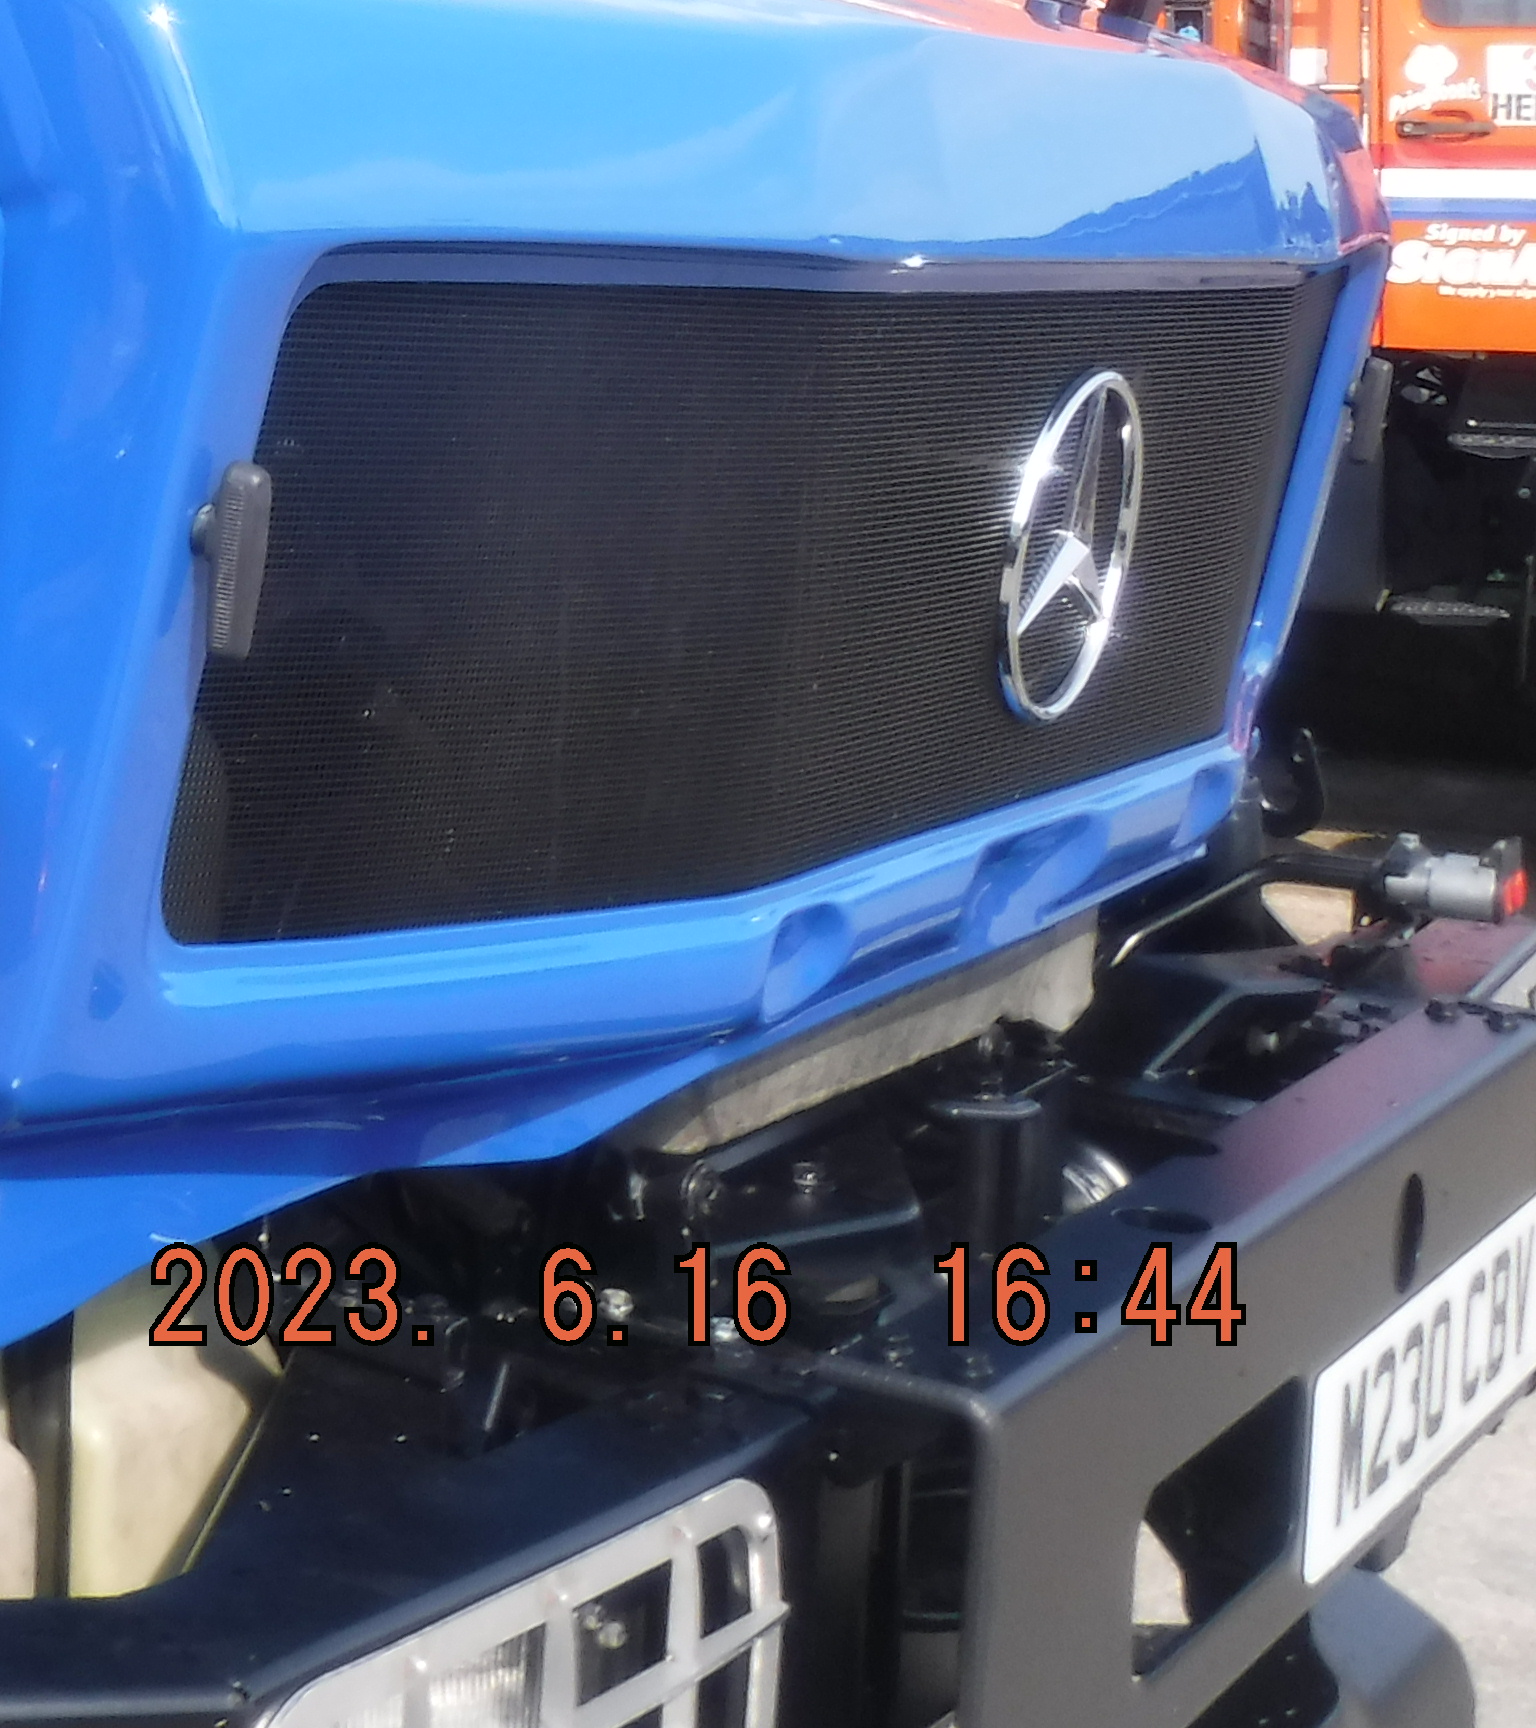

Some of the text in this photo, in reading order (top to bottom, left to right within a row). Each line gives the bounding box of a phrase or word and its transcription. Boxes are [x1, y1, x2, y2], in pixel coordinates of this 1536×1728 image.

[1492, 93, 1536, 121] HE
[1424, 223, 1526, 247] Signed by
[1334, 1222, 1536, 1528] M230 CBV
